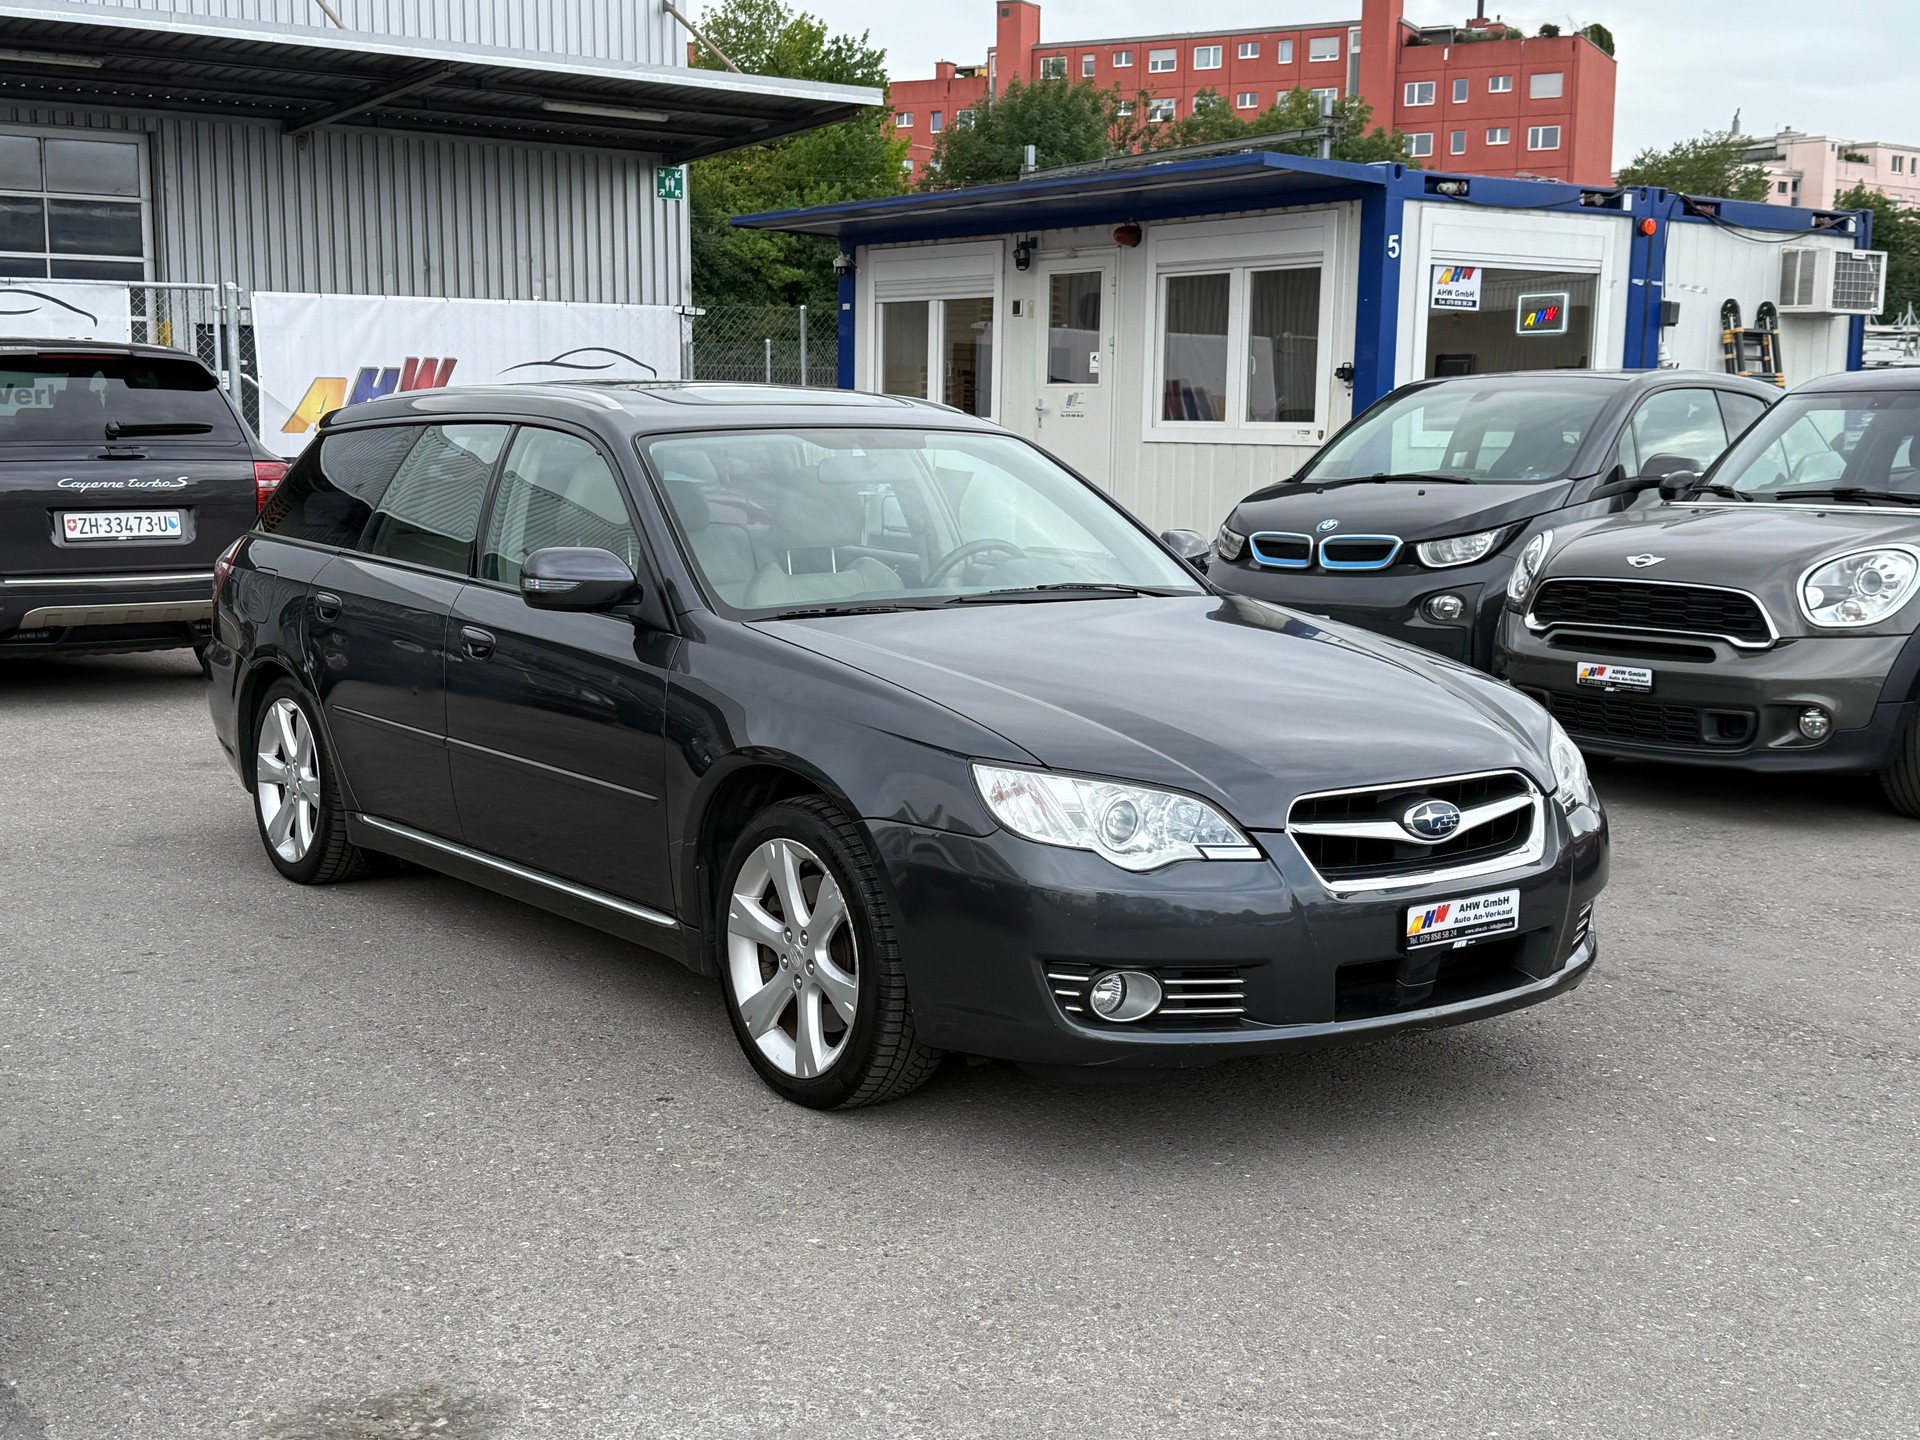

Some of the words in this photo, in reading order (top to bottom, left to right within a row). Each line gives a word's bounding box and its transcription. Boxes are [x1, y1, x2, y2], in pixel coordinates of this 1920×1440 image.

[1388, 234, 1400, 258] 5
[1437, 266, 1476, 285] AHW
[1437, 288, 1453, 297] AHW
[1454, 289, 1475, 298] GmbH
[1524, 306, 1558, 326] AHW
[281, 356, 458, 434] AHW
[57, 478, 125, 493] Cayenne
[1580, 666, 1607, 678] AHW
[1459, 901, 1480, 913] AHW
[1483, 896, 1510, 909] GmbH
[1408, 904, 1451, 935] AHW
[1454, 916, 1471, 925] Auto
[1473, 907, 1513, 921] An-Verkauf
[1409, 937, 1419, 945] Tel.
[1420, 934, 1430, 943] 079
[1431, 932, 1441, 941] 858
[1442, 930, 1450, 939] 58
[1450, 929, 1457, 937] 24
